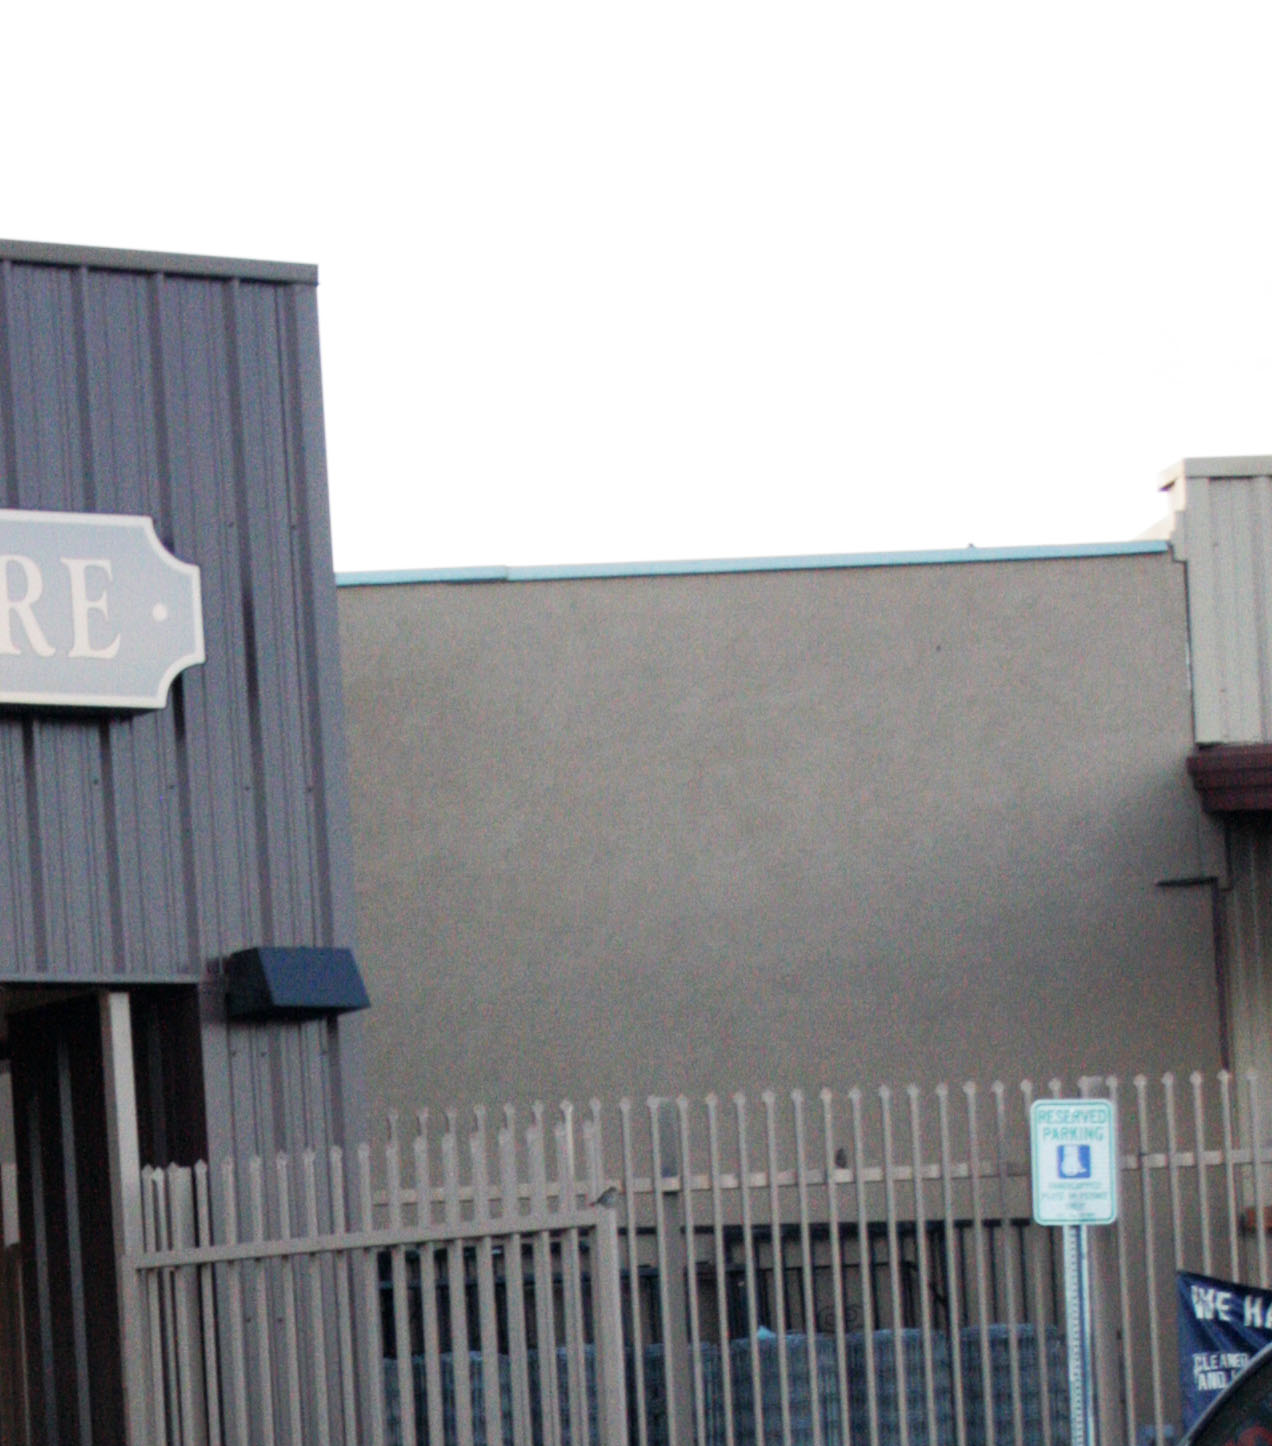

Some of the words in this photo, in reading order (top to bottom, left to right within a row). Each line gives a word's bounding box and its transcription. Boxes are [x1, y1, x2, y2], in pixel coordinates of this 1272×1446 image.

[1038, 1109, 1107, 1125] RESERVED
[1042, 1127, 1104, 1142] PARKING
[1191, 1285, 1232, 1322] WE
